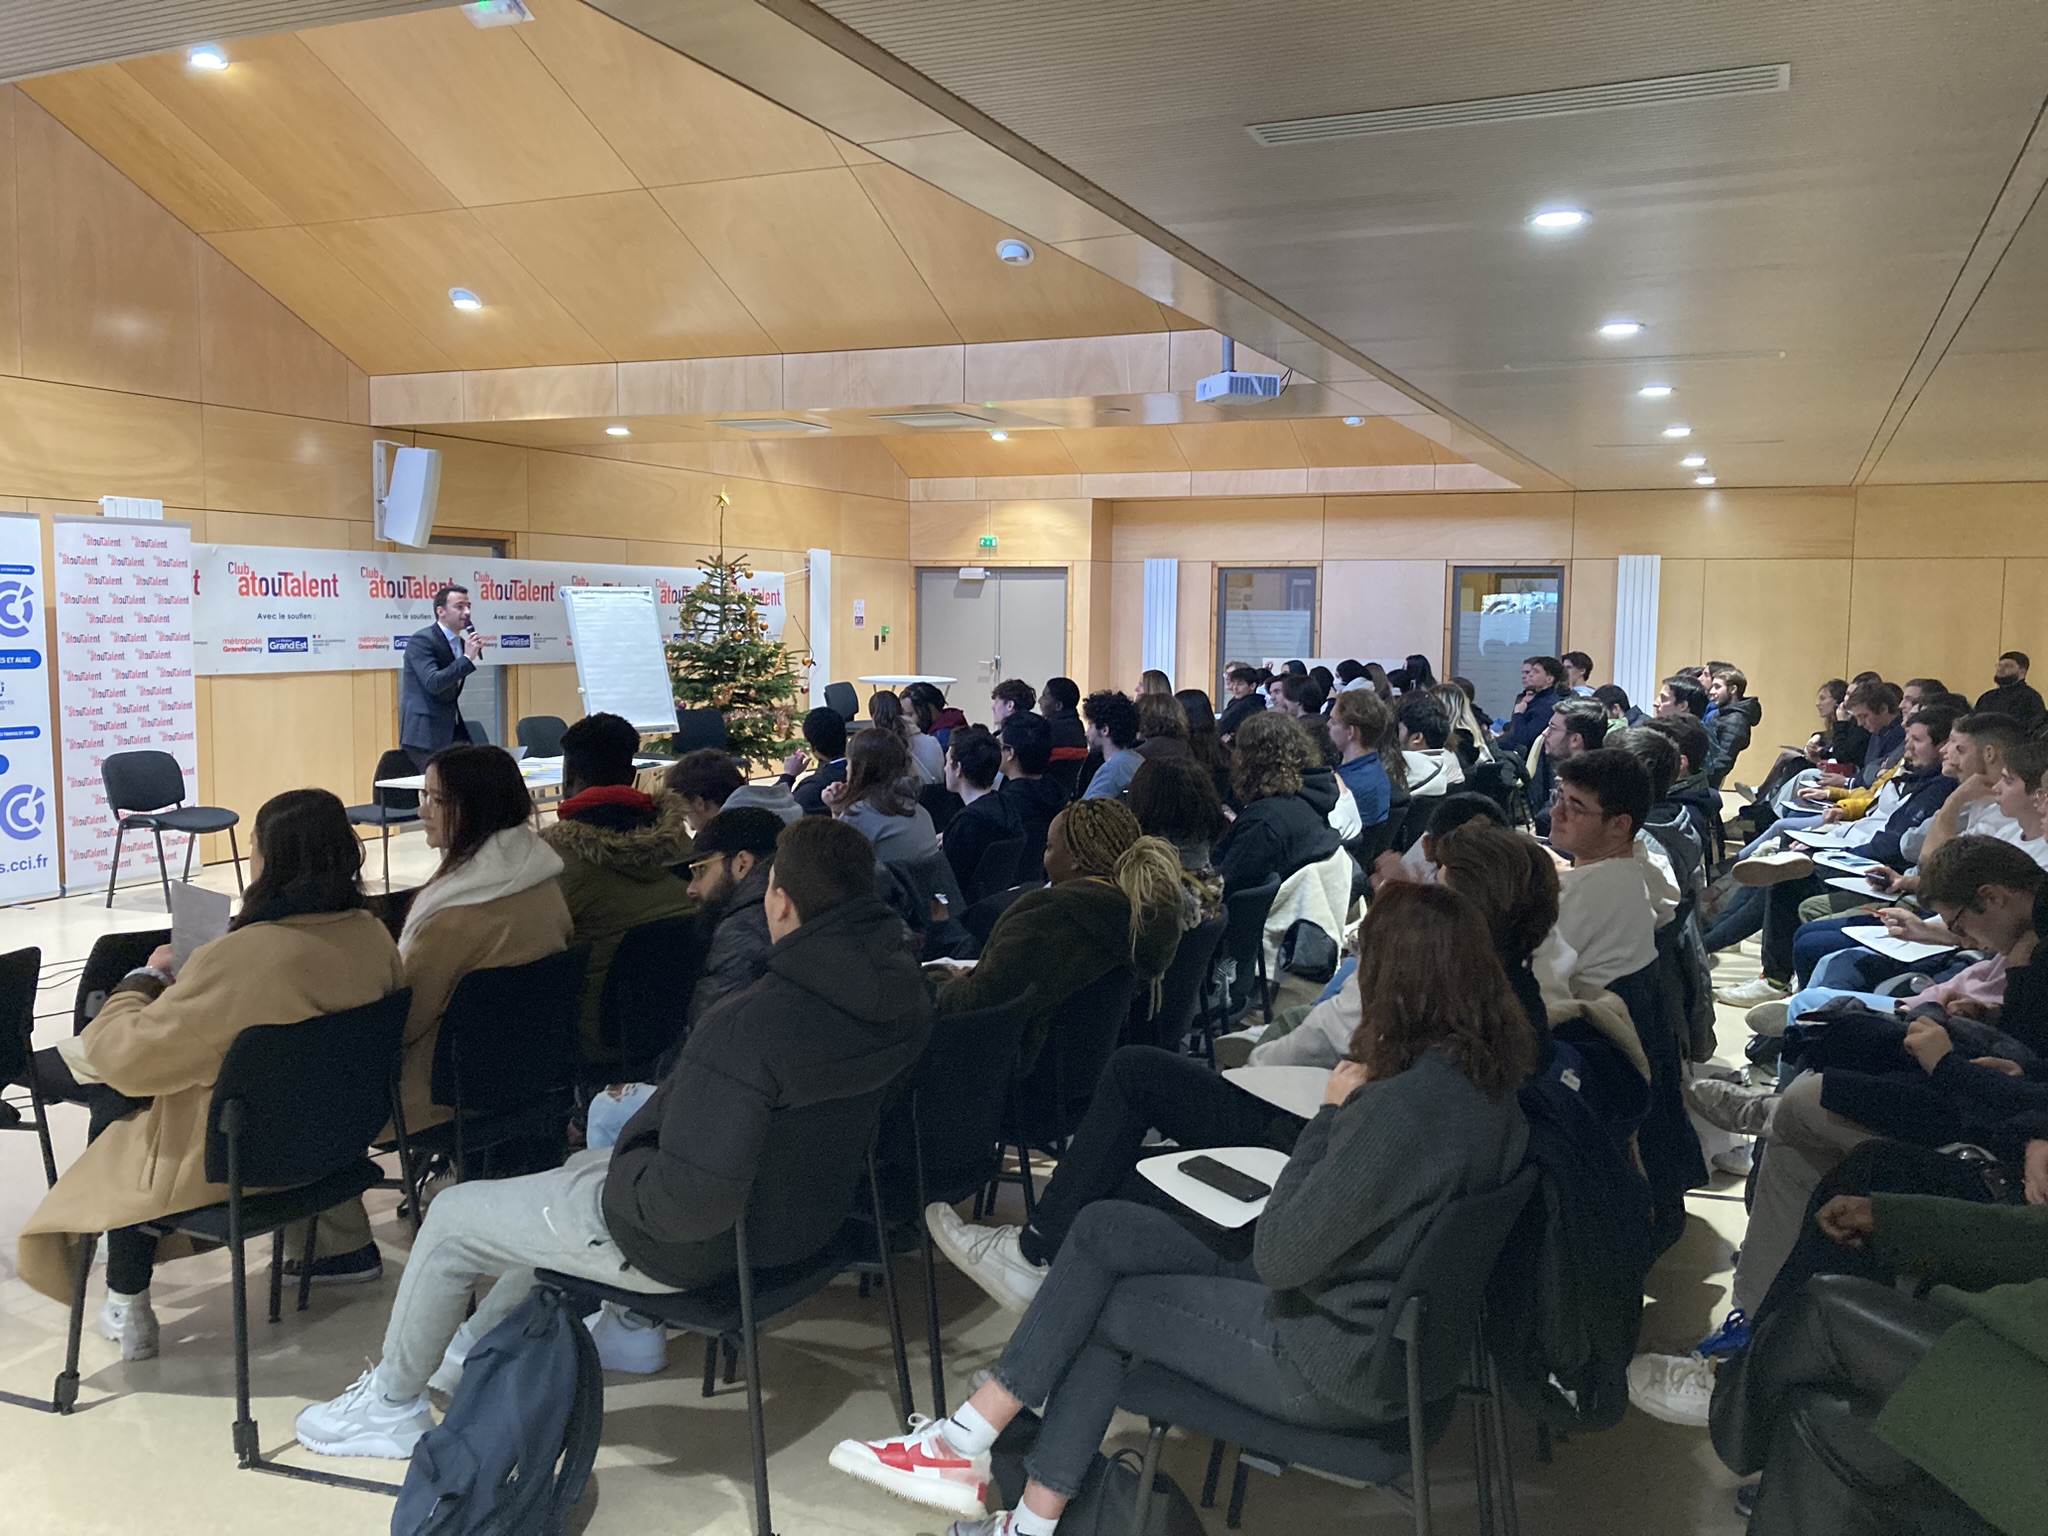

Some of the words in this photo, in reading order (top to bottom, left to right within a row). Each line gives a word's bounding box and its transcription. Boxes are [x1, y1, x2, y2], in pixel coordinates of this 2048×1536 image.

[228, 562, 250, 575] Club
[361, 566, 379, 579] Club
[474, 571, 490, 583] Club
[238, 571, 340, 598] atouTalent
[369, 575, 455, 599] atouTale
[480, 578, 555, 602] atouTalent
[222, 637, 263, 647] métropole
[269, 641, 294, 650] Grand
[295, 641, 308, 650] Est
[71, 778, 103, 788] atouTalen
